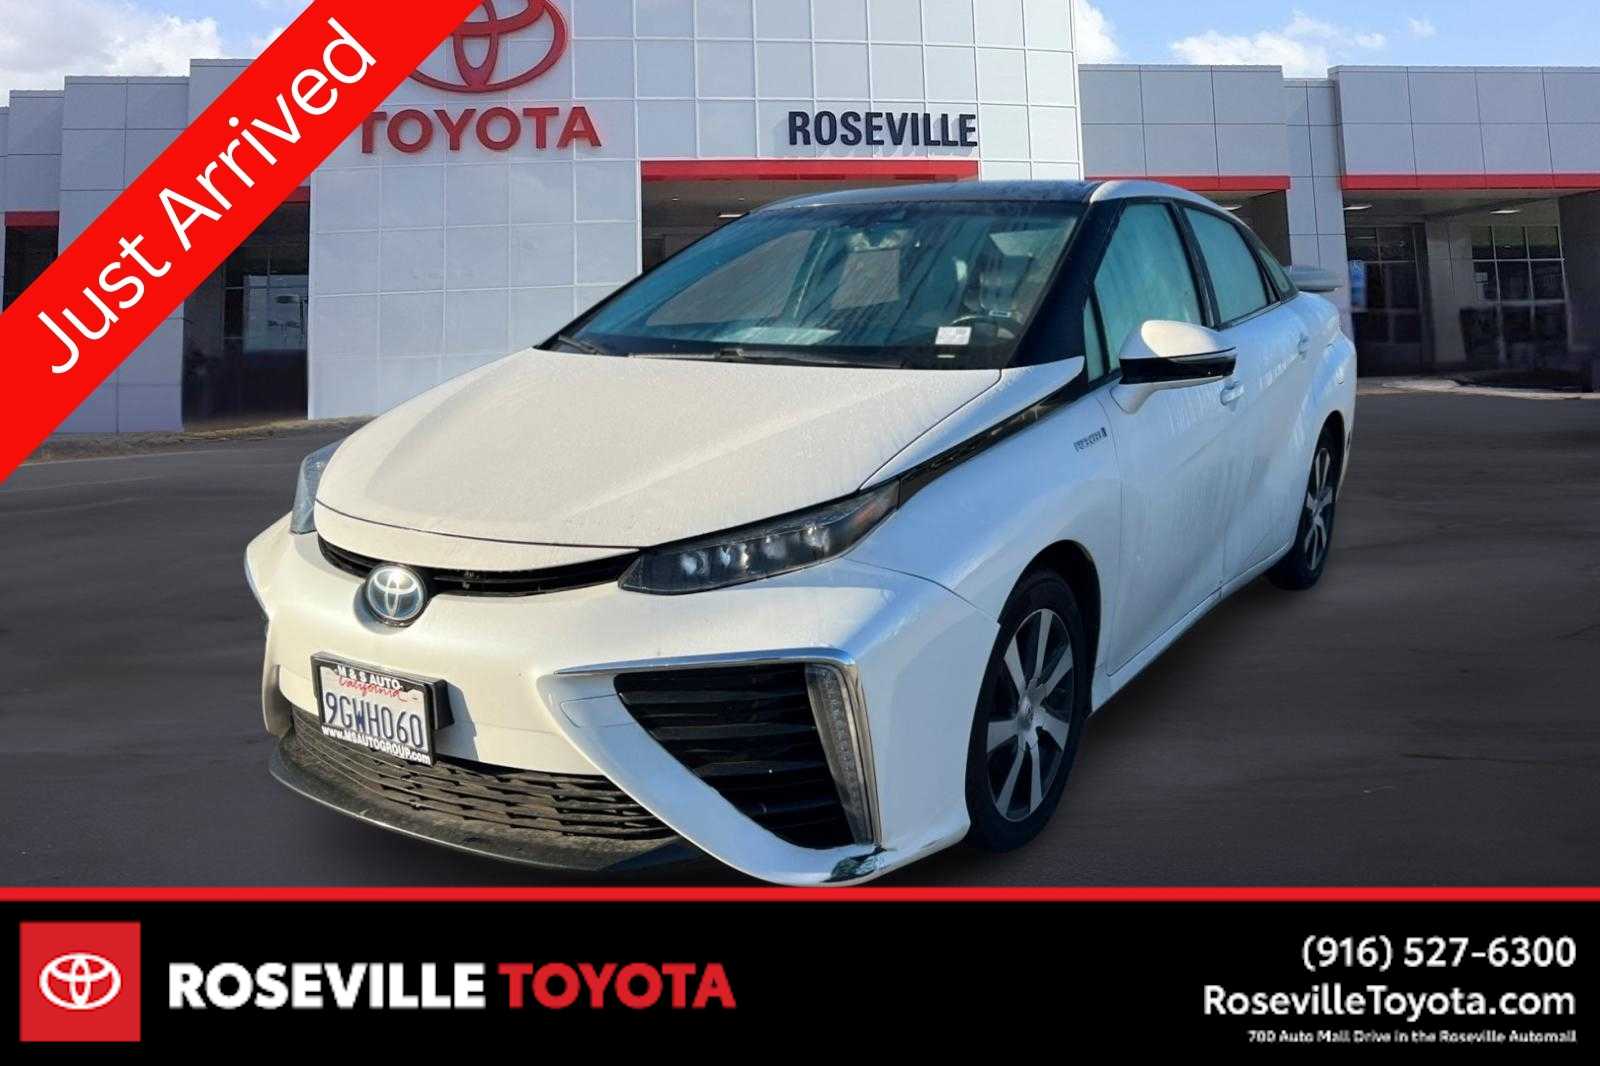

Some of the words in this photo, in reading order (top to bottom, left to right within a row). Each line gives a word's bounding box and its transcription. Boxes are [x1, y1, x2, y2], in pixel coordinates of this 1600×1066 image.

[361, 106, 602, 154] TOYOTA
[788, 110, 978, 147] ROSEVILLE
[325, 691, 424, 748] 9GWH060
